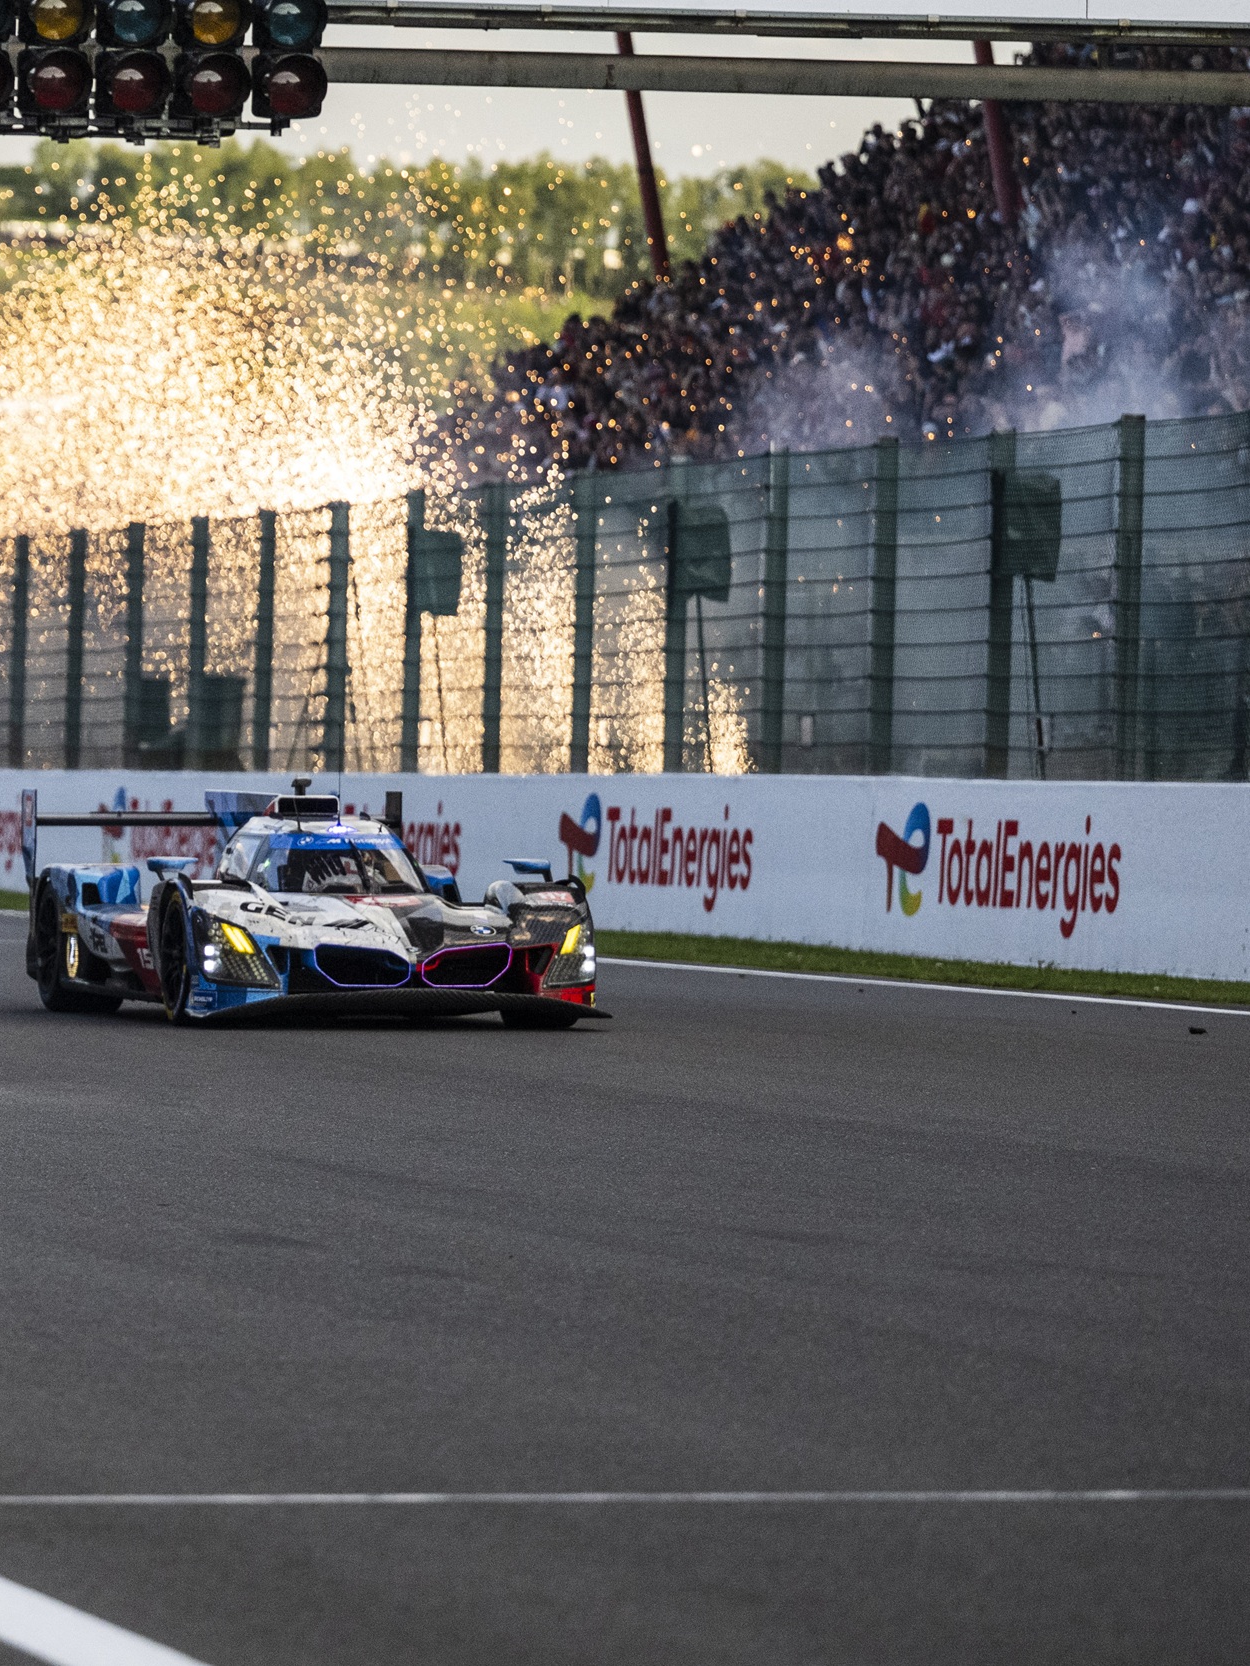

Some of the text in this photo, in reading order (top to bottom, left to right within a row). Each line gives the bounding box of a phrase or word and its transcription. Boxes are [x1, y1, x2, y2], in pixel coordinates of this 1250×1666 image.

[606, 804, 753, 912] TotalEnergies
[936, 815, 1121, 939] TotalEnergies
[240, 901, 316, 926] GEN
